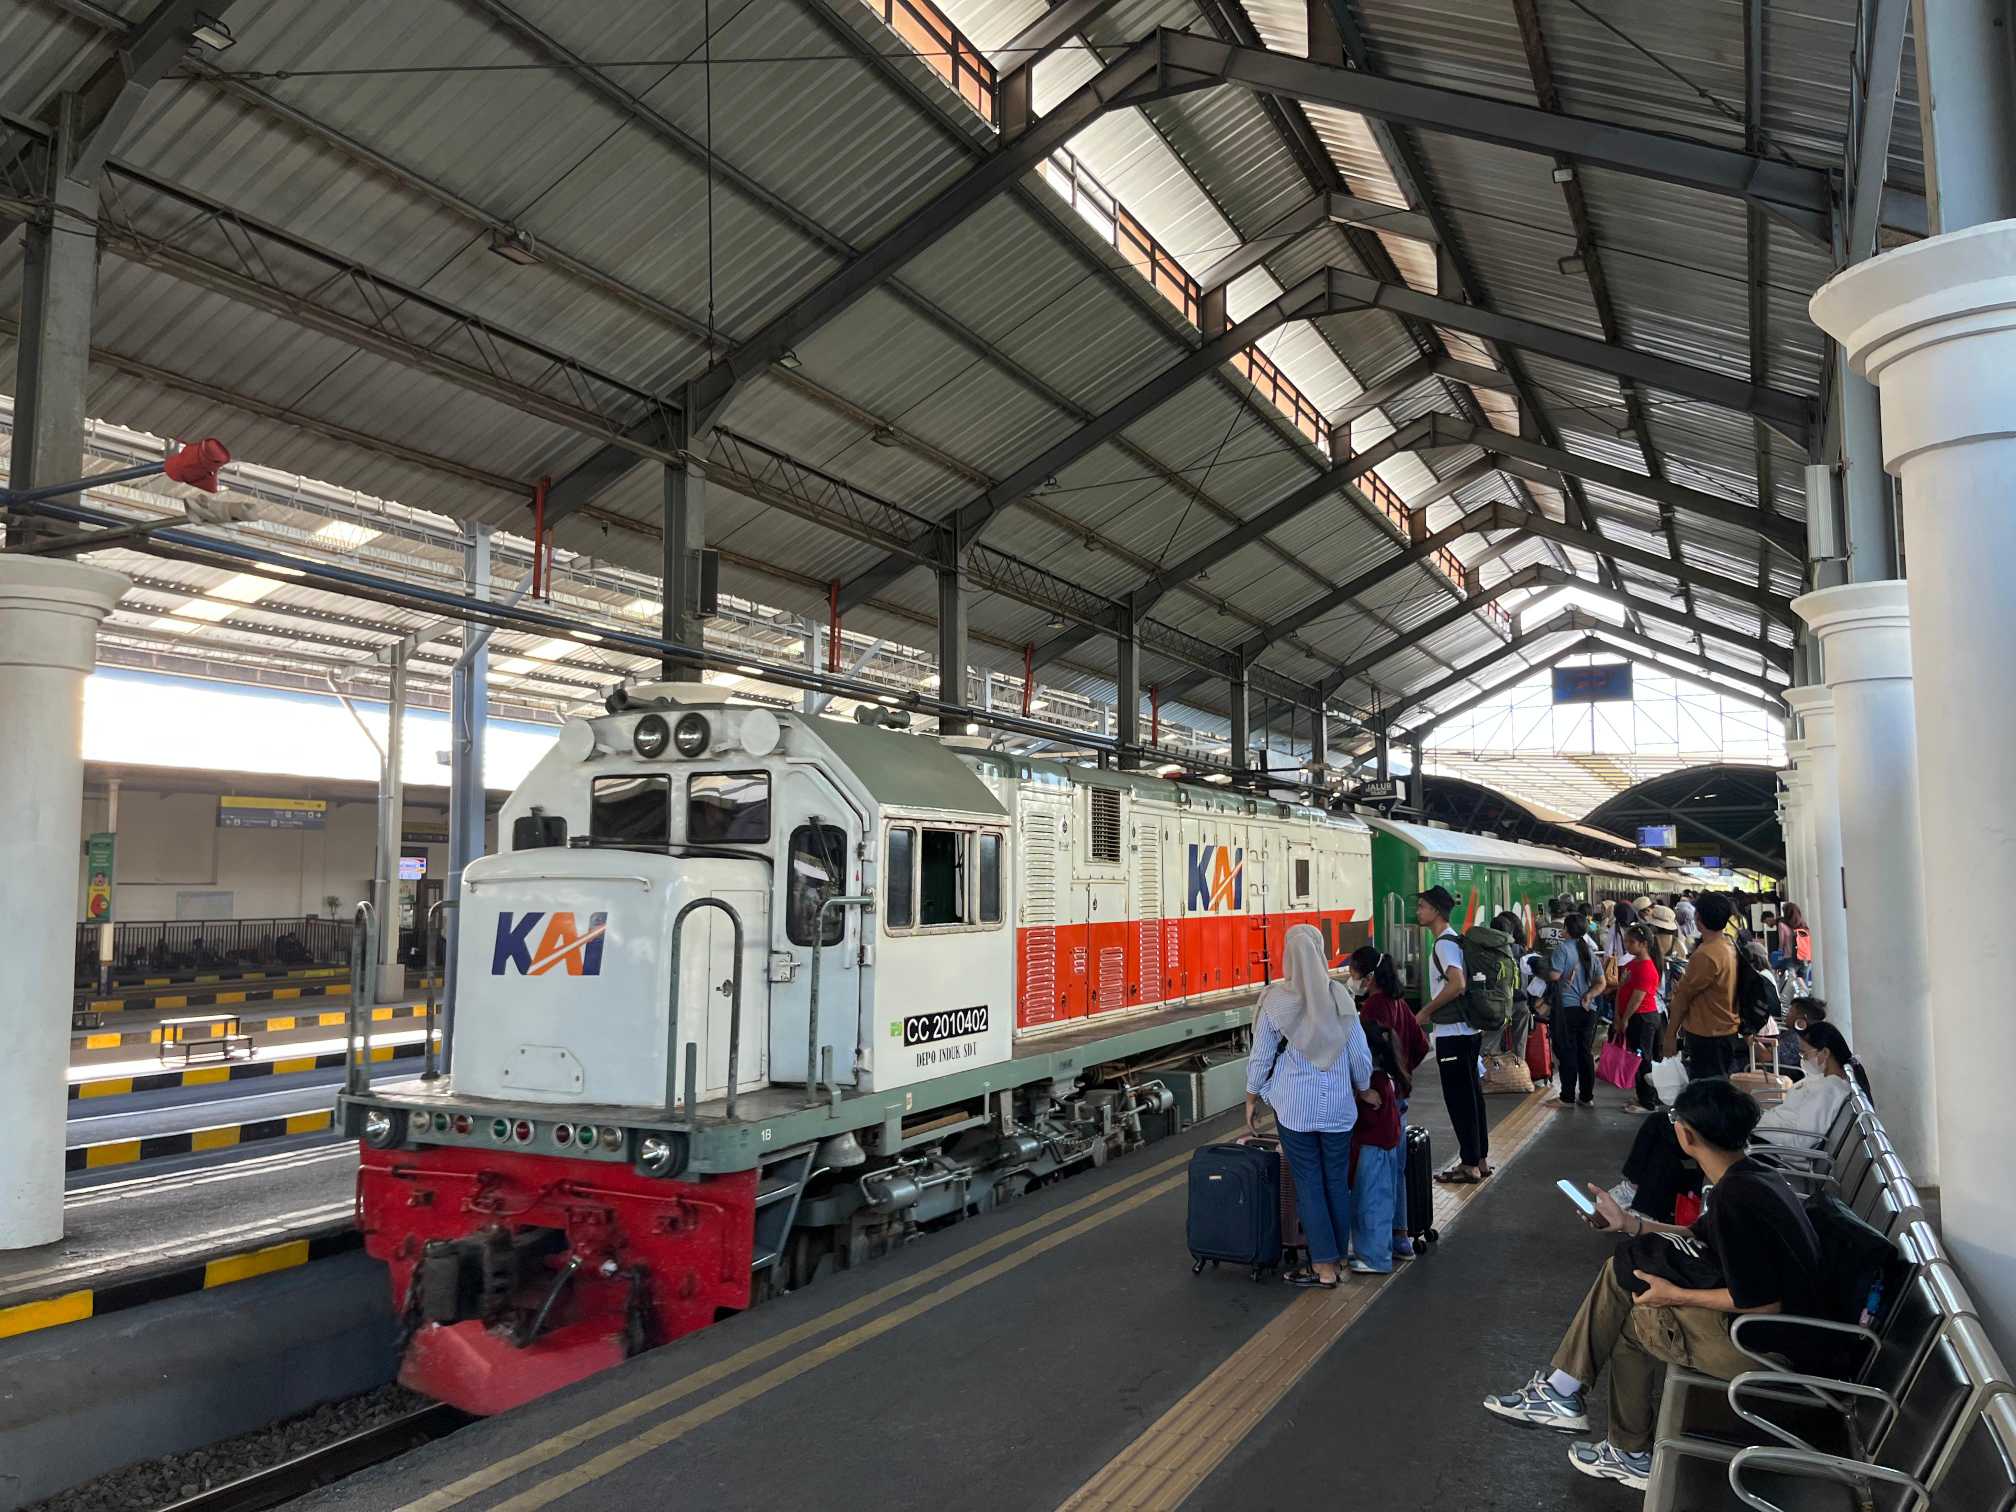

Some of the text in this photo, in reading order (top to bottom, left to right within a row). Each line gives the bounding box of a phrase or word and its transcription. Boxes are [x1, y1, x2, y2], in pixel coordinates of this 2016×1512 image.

[1366, 782, 1392, 790] JALUR
[1378, 802, 1387, 811] 6
[1187, 843, 1243, 912] KAI
[491, 911, 608, 976] KAI
[906, 1008, 987, 1043] CC 2010402
[916, 1050, 937, 1068] DEPO
[939, 1045, 961, 1062] INDUK
